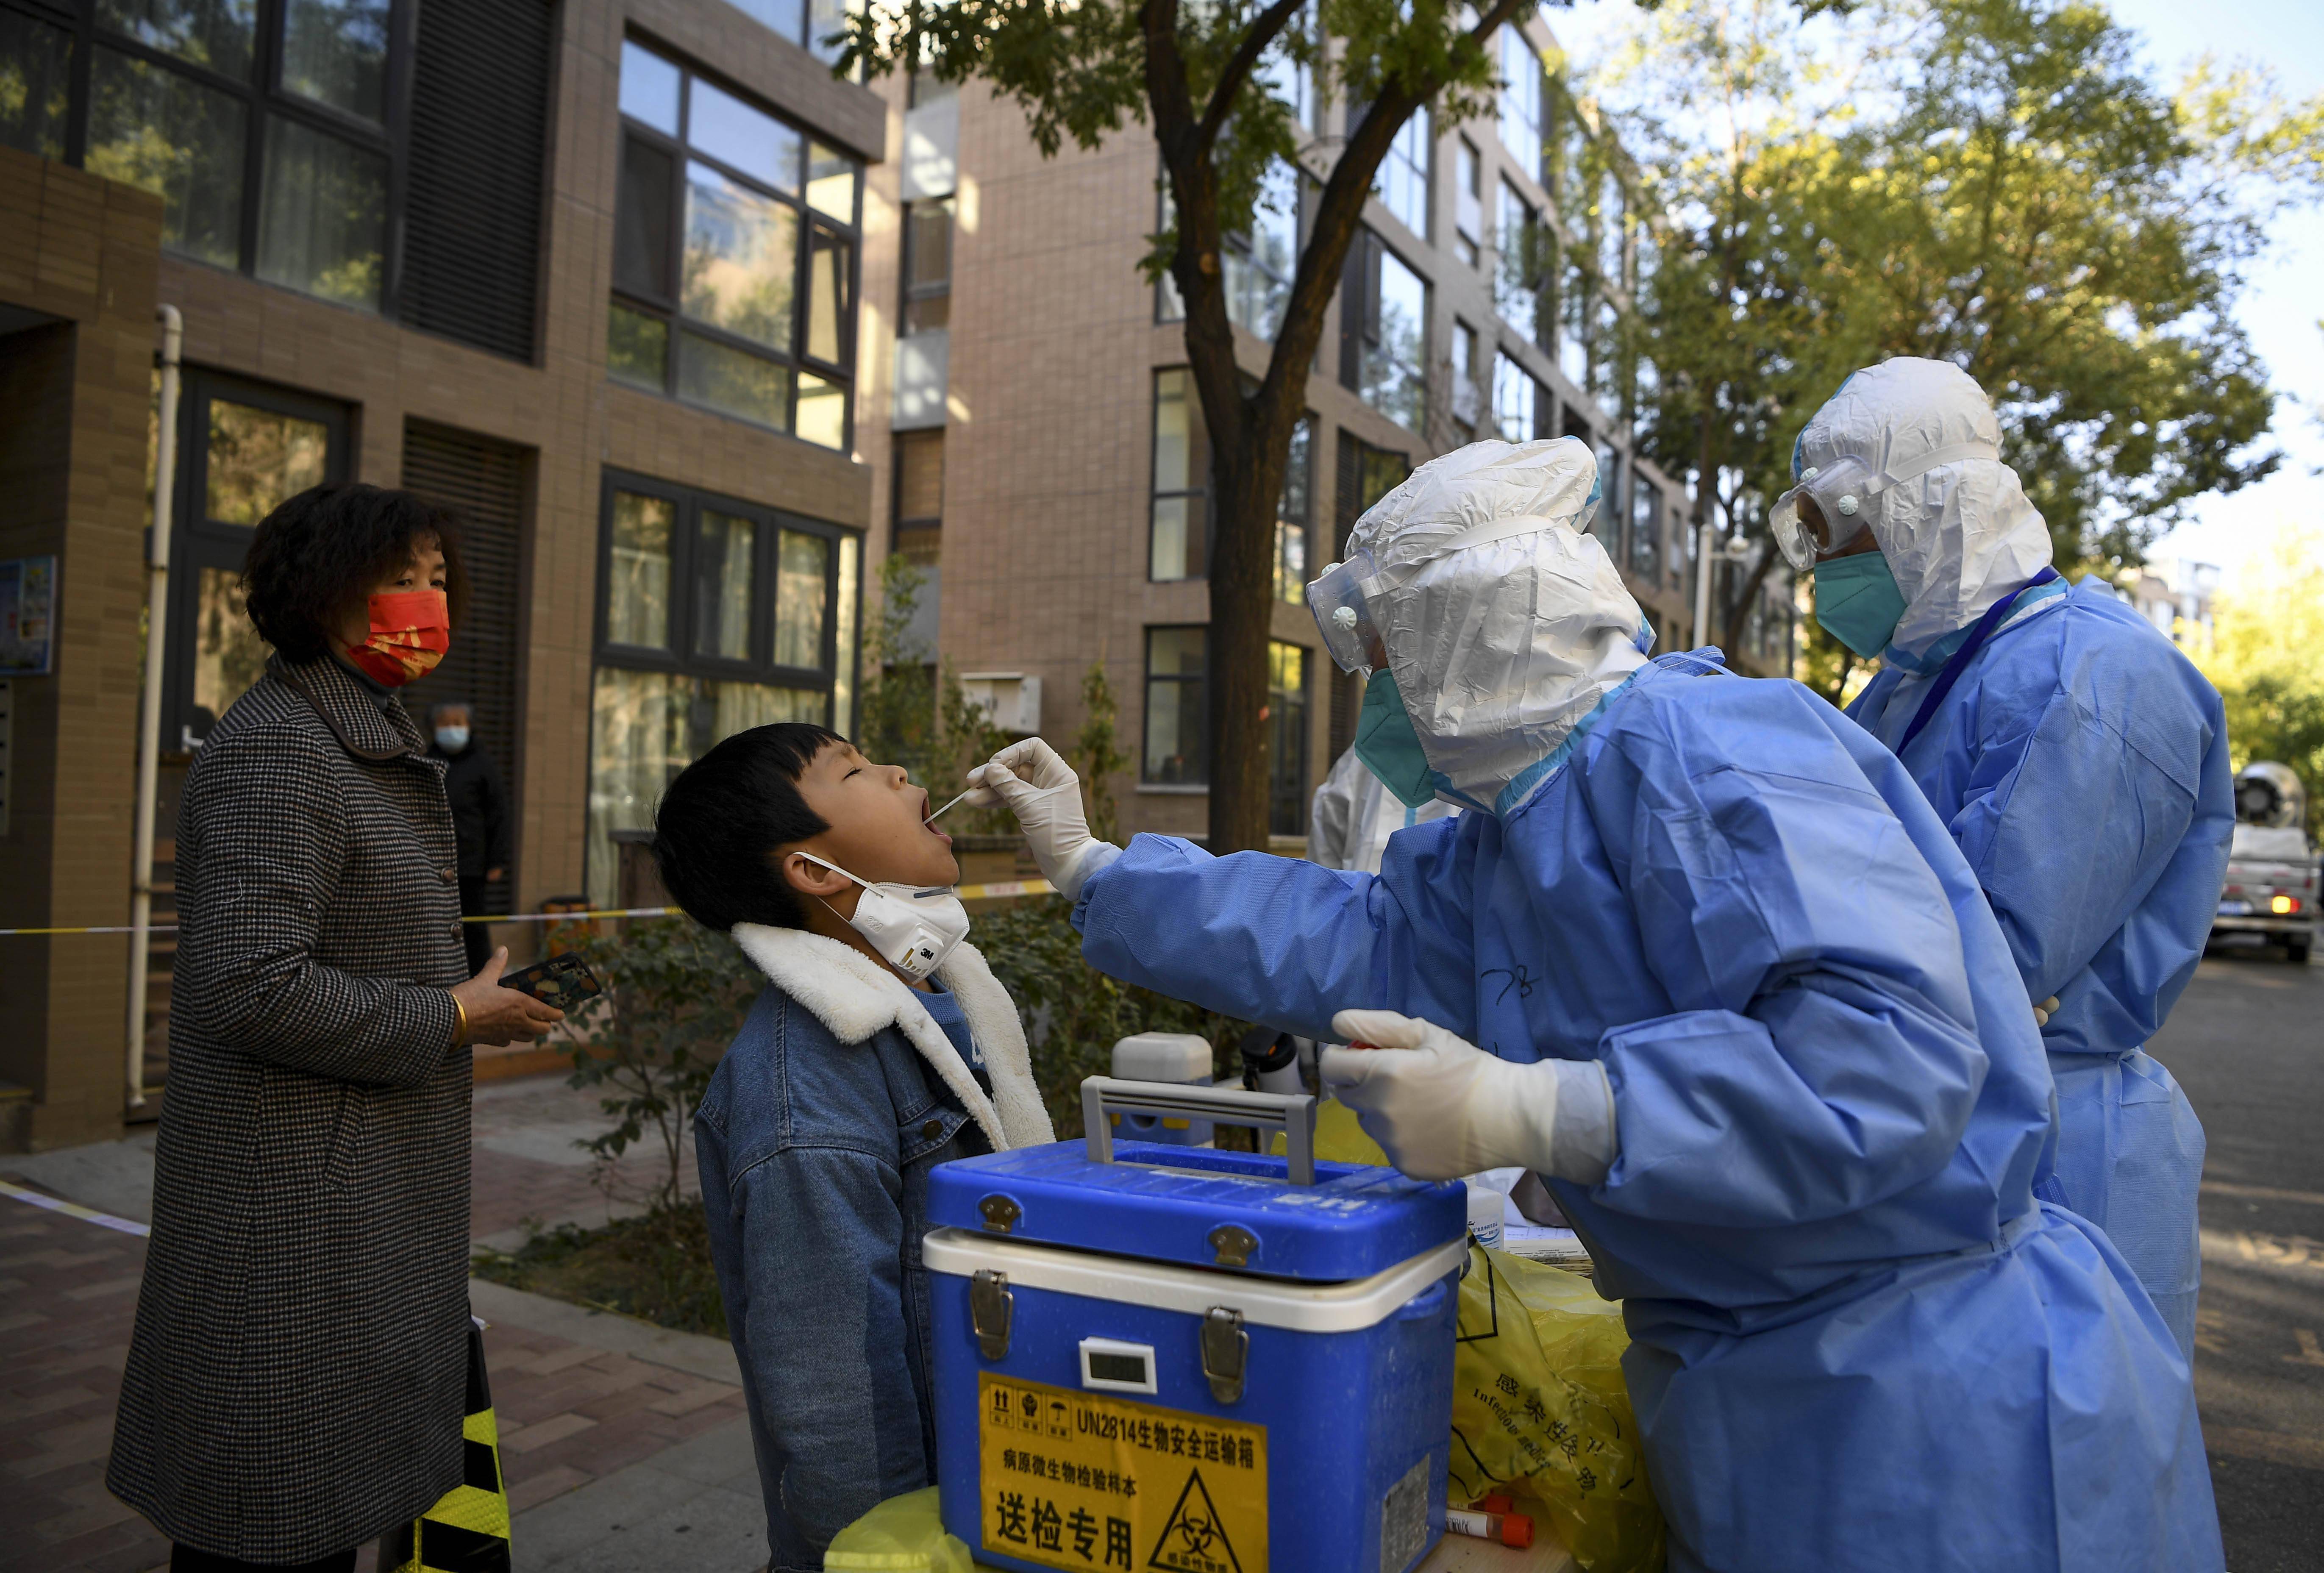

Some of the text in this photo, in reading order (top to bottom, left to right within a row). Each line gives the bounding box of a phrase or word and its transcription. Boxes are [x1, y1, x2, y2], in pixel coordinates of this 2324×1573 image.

[866, 915, 884, 932] 3M
[920, 948, 934, 961] 3M
[1003, 1448, 1137, 1498] 病原微生物检验样本
[996, 1490, 1132, 1571] 送检专用
